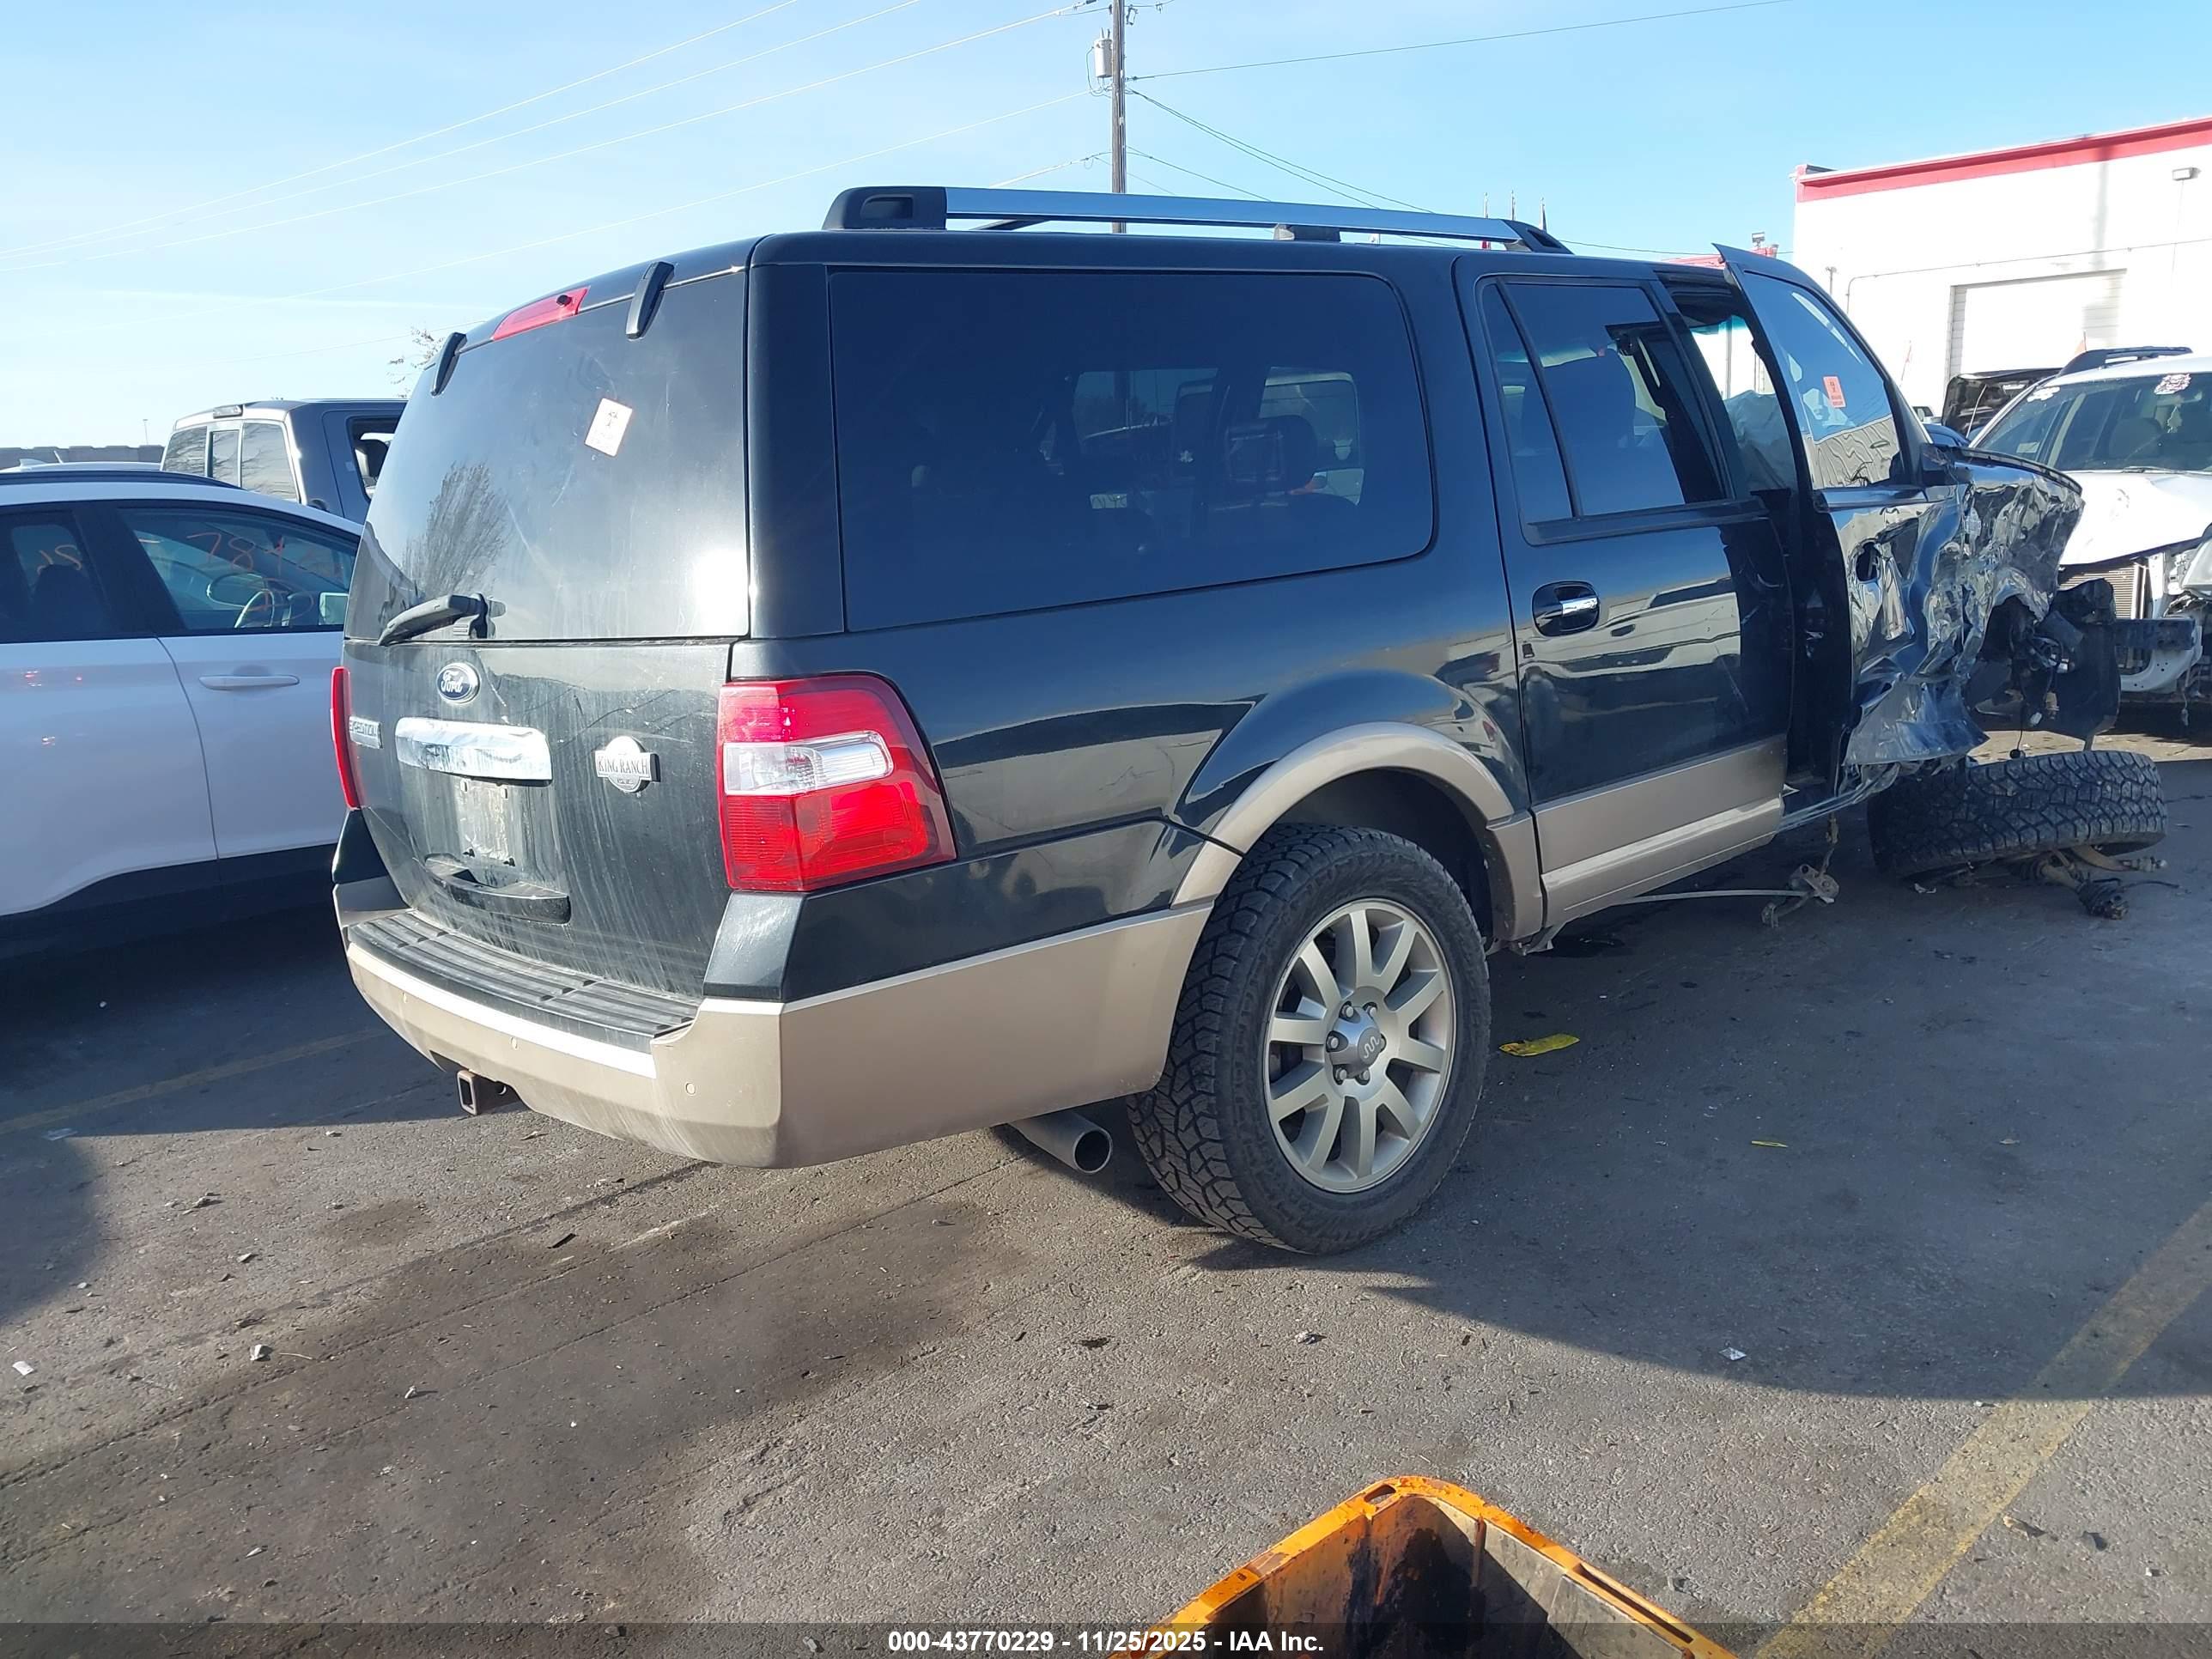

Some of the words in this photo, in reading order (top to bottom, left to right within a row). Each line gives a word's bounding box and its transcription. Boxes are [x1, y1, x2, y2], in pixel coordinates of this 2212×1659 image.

[441, 669, 465, 693] Ford
[598, 756, 619, 774] KING
[620, 758, 648, 775] RANCH
